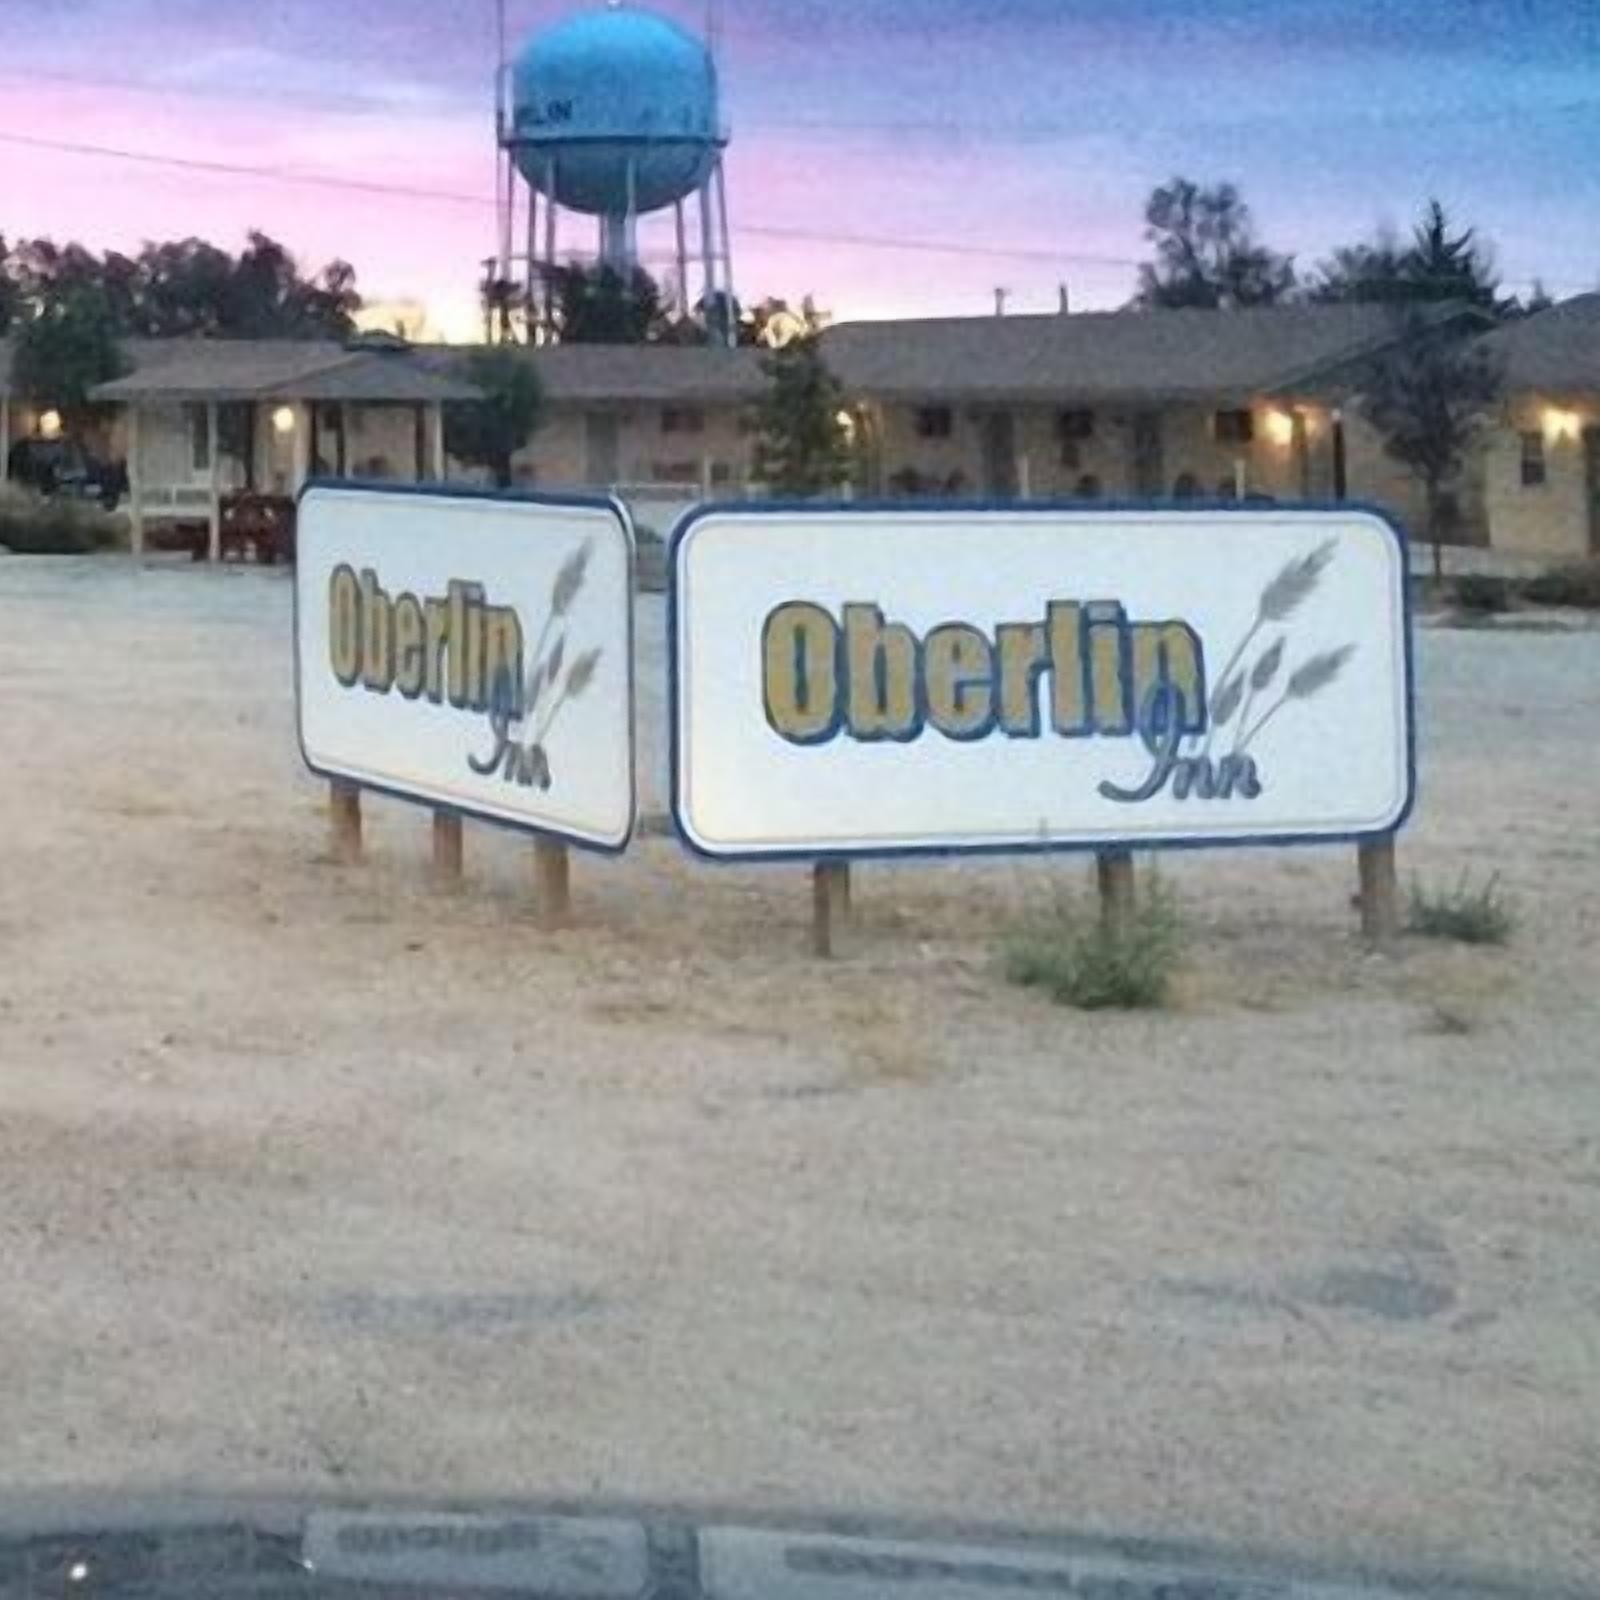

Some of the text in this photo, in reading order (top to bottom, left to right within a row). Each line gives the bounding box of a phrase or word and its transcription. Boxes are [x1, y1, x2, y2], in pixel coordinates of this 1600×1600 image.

[328, 563, 524, 721] Oberlin
[761, 600, 1208, 746] Oberlin
[467, 663, 552, 791] Inn
[1096, 679, 1262, 802] Inn
